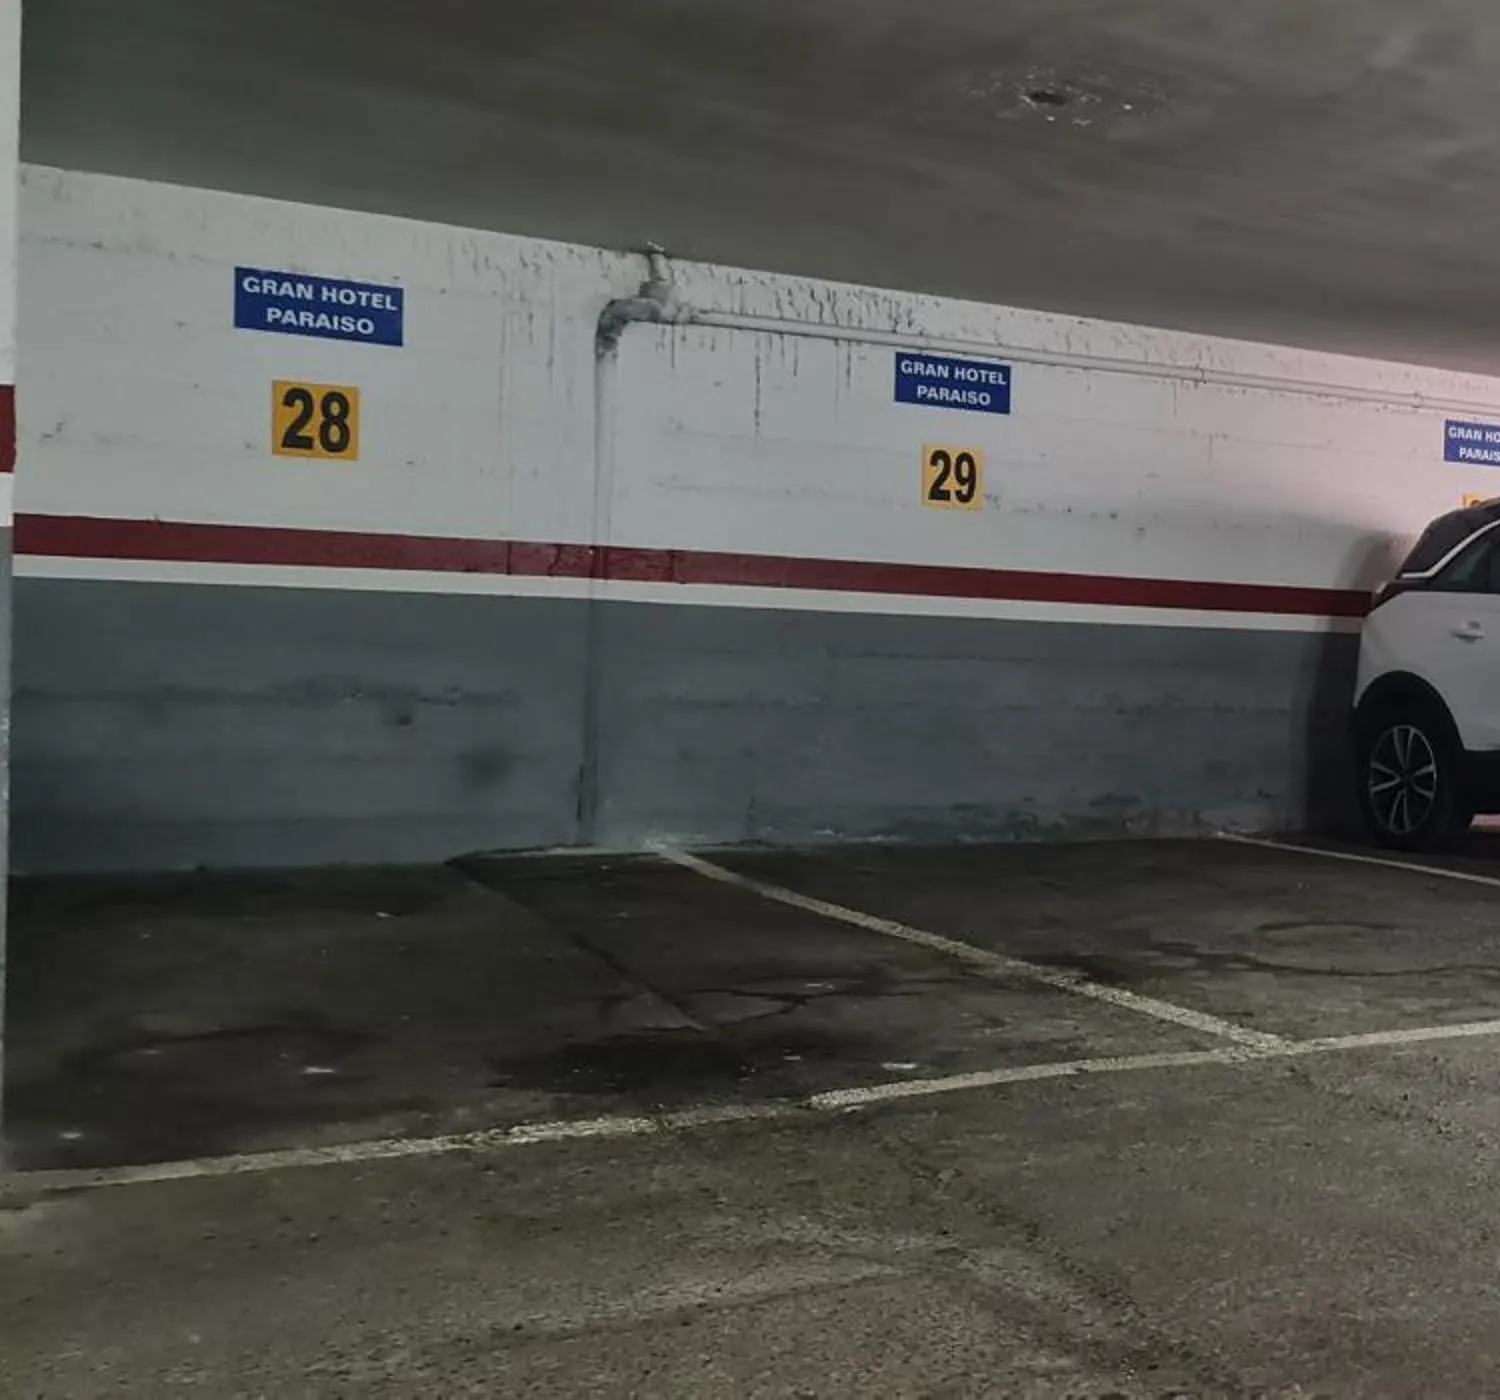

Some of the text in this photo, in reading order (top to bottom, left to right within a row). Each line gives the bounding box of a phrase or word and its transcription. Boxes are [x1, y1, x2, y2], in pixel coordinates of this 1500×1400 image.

[242, 277, 398, 311] GRAN HOTEL
[266, 307, 375, 334] PARAISO
[900, 360, 1007, 385] GRAN HOTEL
[917, 385, 991, 406] PARAISO
[281, 387, 351, 453] 28
[1448, 426, 1481, 441] GRAN
[928, 449, 977, 503] 29
